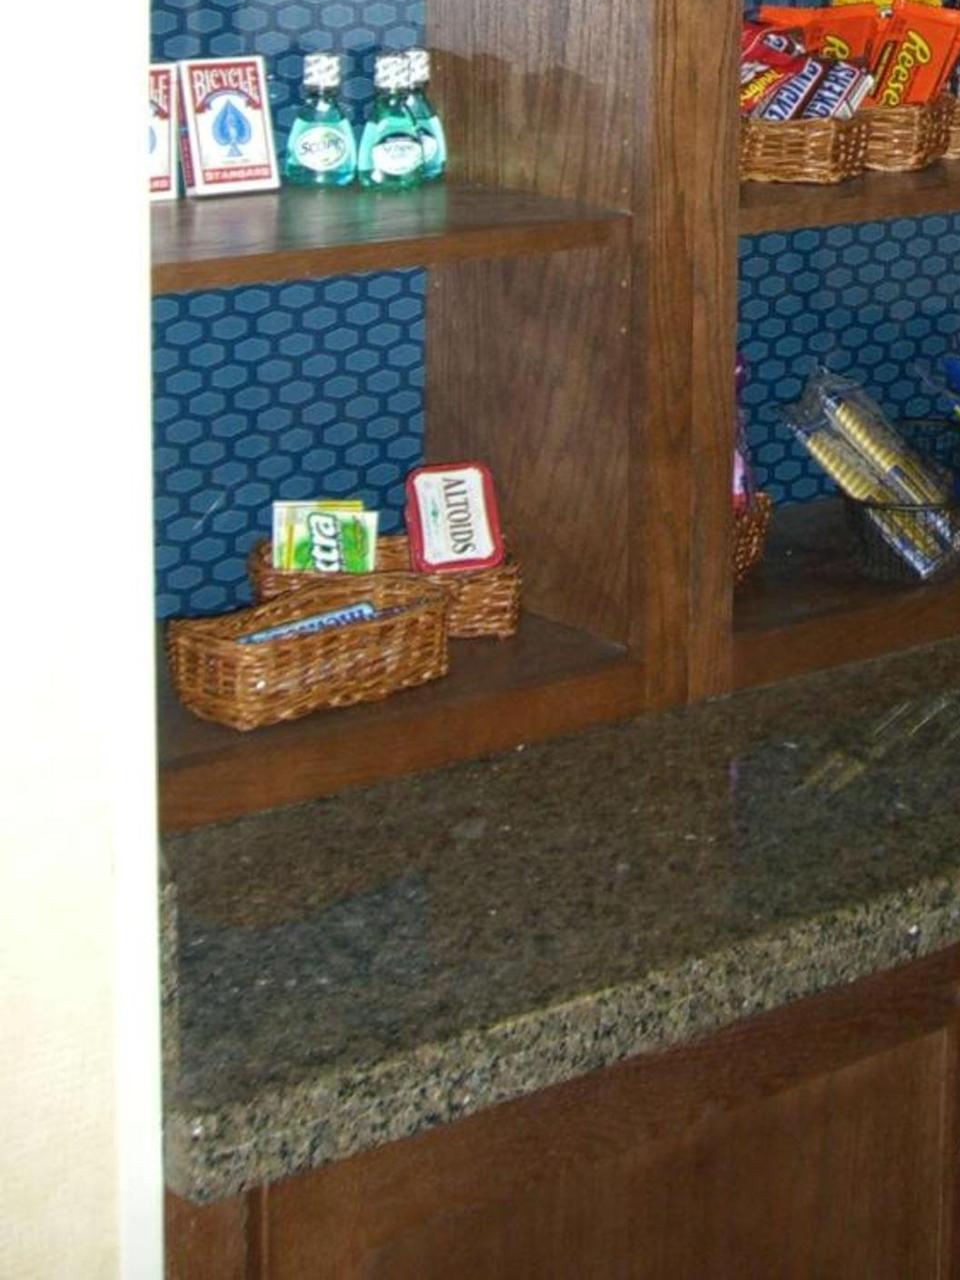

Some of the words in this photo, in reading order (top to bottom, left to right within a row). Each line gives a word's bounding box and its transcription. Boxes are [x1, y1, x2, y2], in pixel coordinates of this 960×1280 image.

[192, 66, 262, 110] BICYCLE
[764, 60, 820, 120] SNICKE
[803, 63, 858, 119] CKERS
[308, 511, 341, 572] xtra
[442, 477, 477, 555] ALTOIDS
